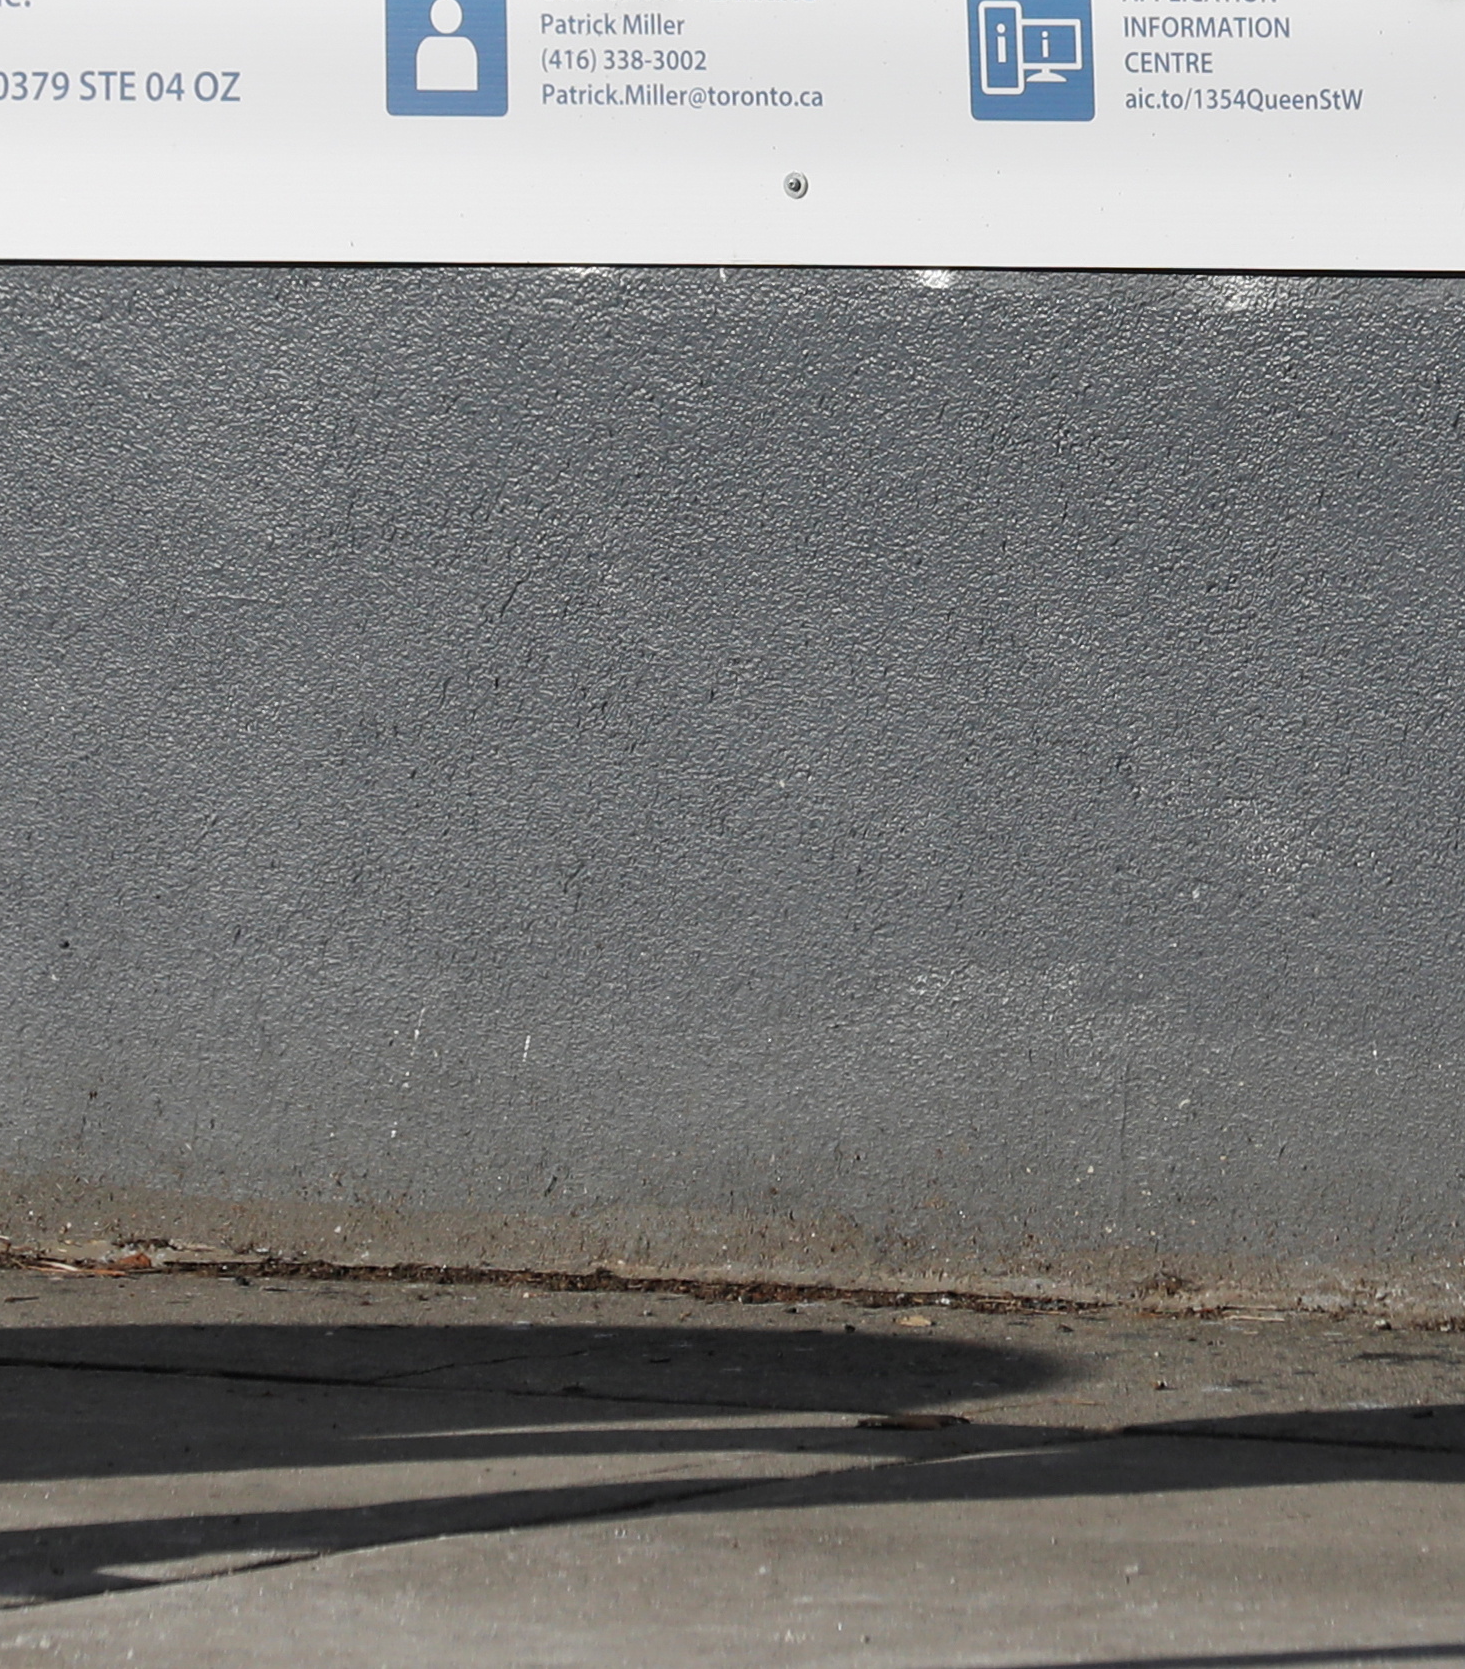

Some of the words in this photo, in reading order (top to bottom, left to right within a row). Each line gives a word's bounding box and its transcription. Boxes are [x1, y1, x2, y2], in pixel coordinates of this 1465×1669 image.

[539, 12, 617, 36] Patrick
[621, 12, 685, 36] Miller
[1123, 16, 1291, 40] INFORMATION
[540, 47, 597, 75] (416)
[603, 48, 707, 72] 338-3002
[1124, 52, 1214, 75] CENTRE
[79, 70, 137, 102] STE
[146, 71, 185, 102] 04
[194, 70, 242, 102] OZ
[541, 82, 824, 110] Patrick.Miller@toronto.ca
[1124, 86, 1365, 114] aic.to/1354QueenStW
